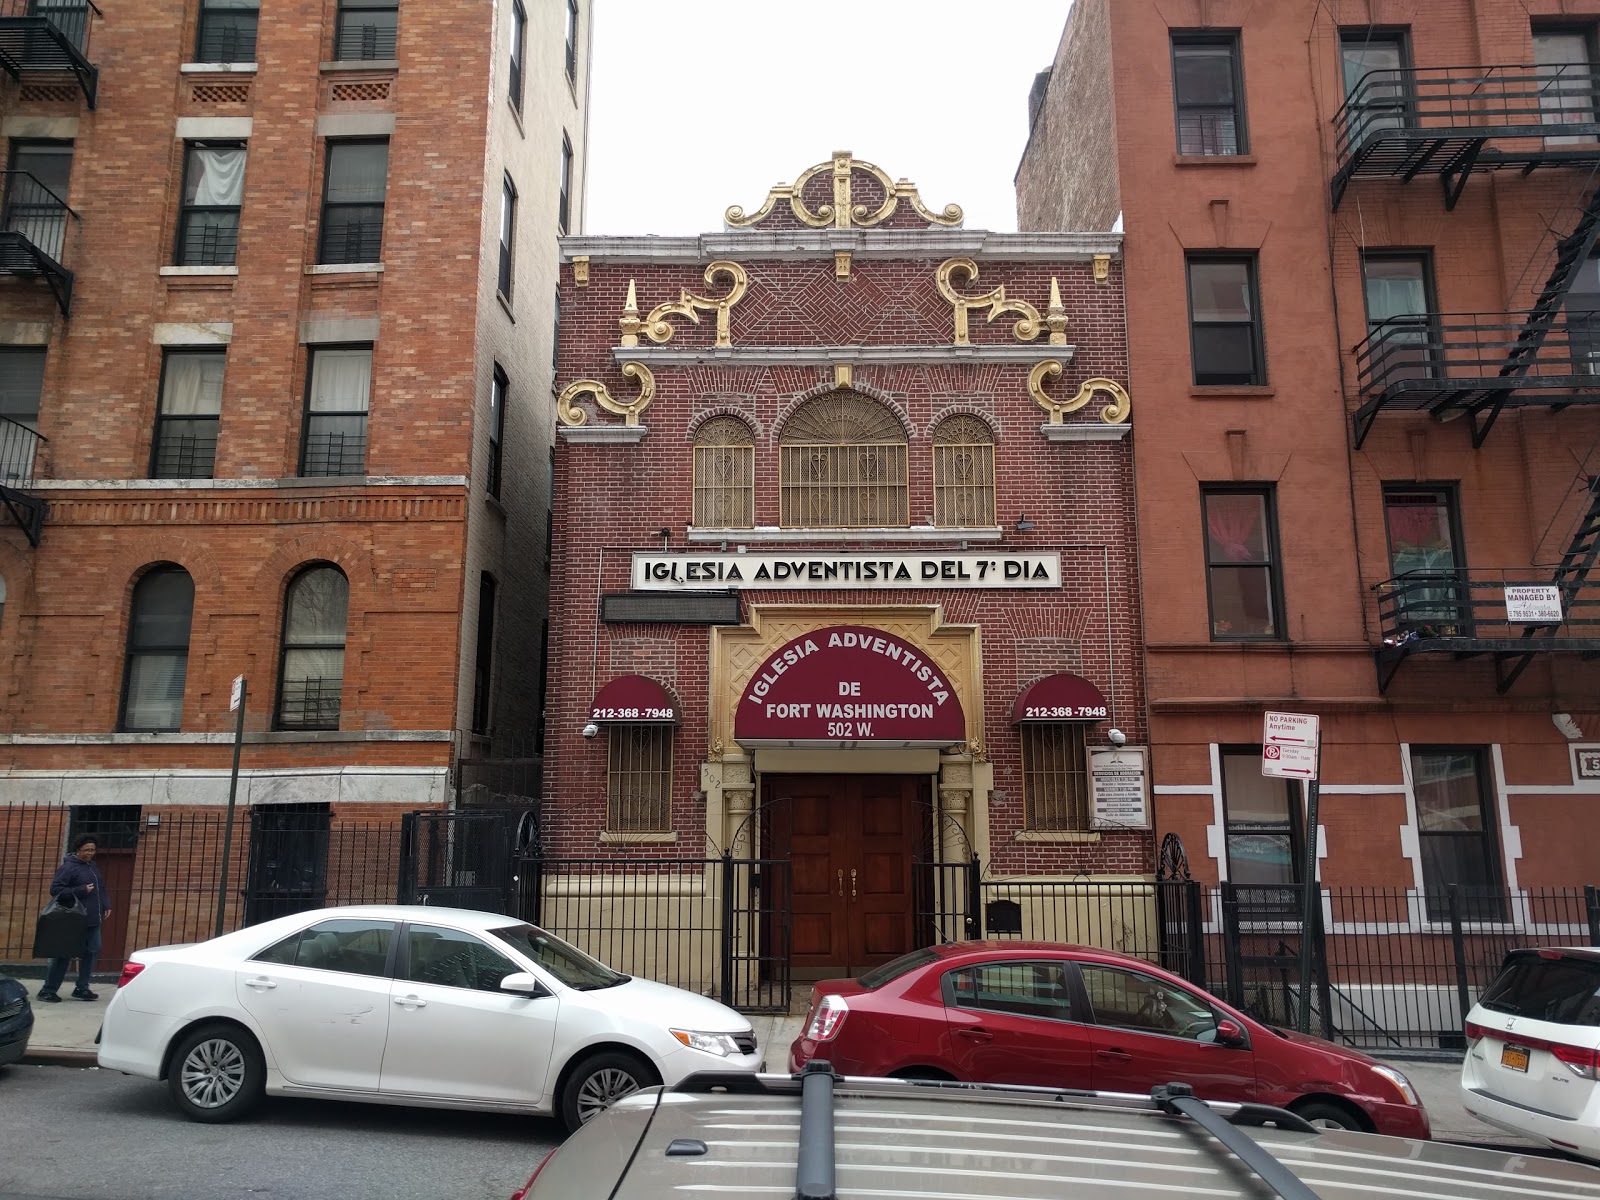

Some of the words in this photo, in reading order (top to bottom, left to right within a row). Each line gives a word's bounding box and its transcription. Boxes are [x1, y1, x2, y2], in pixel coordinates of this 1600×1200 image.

[645, 562, 744, 583] IGLESIA
[754, 561, 912, 580] ADVENTISTA
[921, 561, 970, 579] DEL
[1004, 561, 1050, 579] DIA
[748, 639, 819, 705] IGLESIA
[828, 632, 950, 706] ADVENTISTA
[838, 681, 861, 696] DE
[766, 704, 811, 718] FORT
[816, 704, 934, 718] WASHINGTON
[1269, 723, 1295, 731] Anytime
[1280, 716, 1307, 724] PARKING
[827, 722, 853, 737] 502
[857, 722, 875, 737] W.
[704, 768, 721, 789] 502
